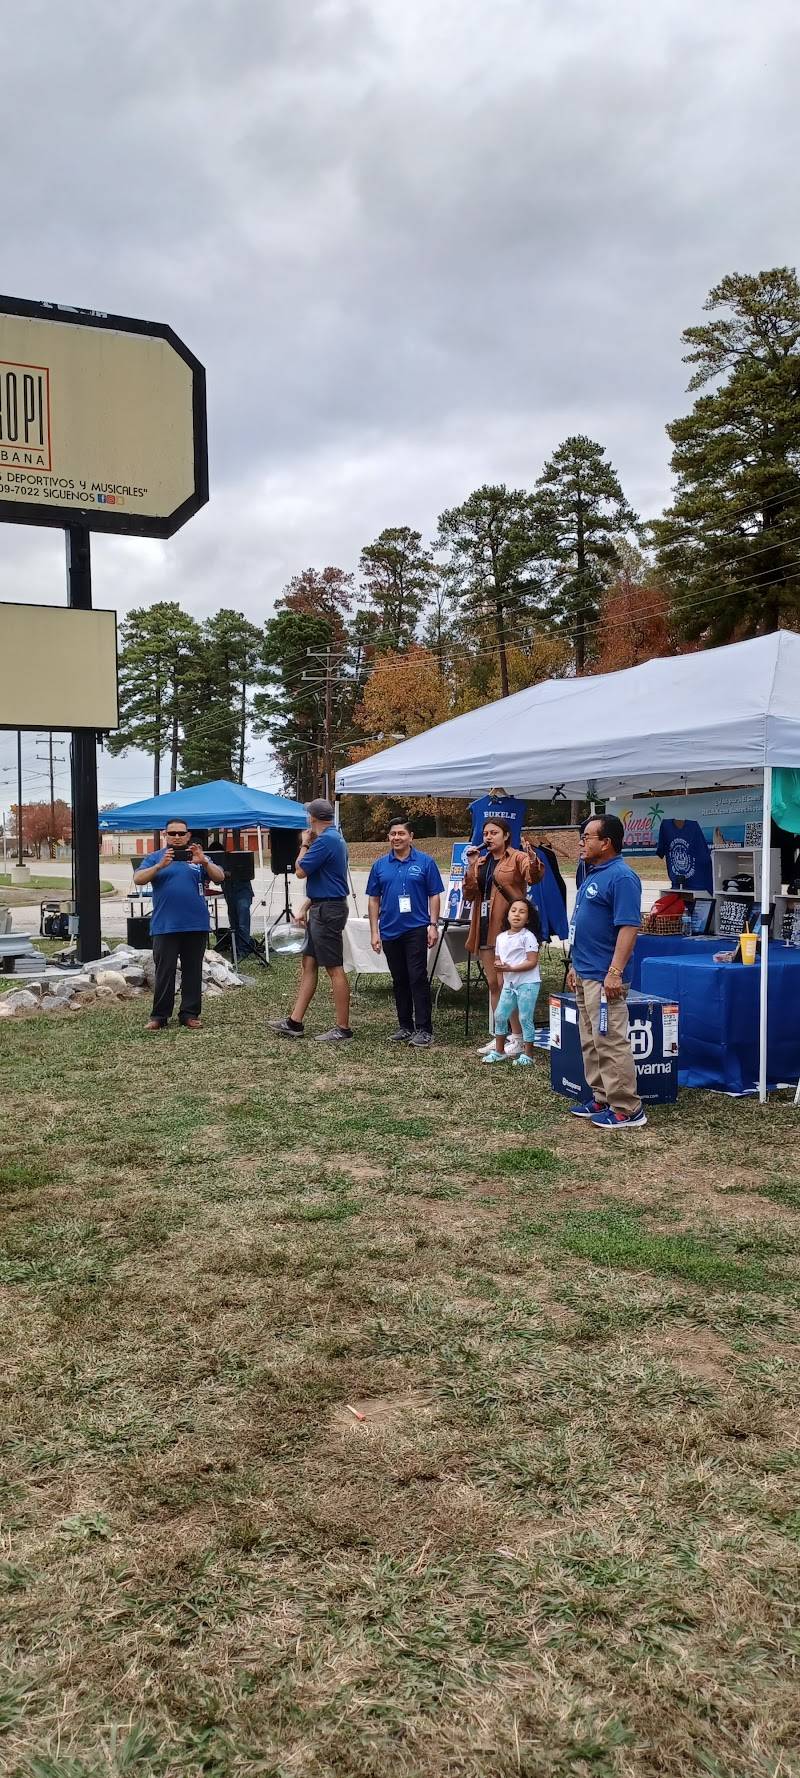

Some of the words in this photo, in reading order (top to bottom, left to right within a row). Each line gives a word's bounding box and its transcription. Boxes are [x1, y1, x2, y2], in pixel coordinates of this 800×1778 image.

[7, 472, 75, 489] DEPORTIVOS
[43, 488, 95, 502] SIGUENOS
[483, 811, 517, 820] BUKELE
[624, 831, 657, 847] OTEL
[635, 1062, 672, 1075] varna
